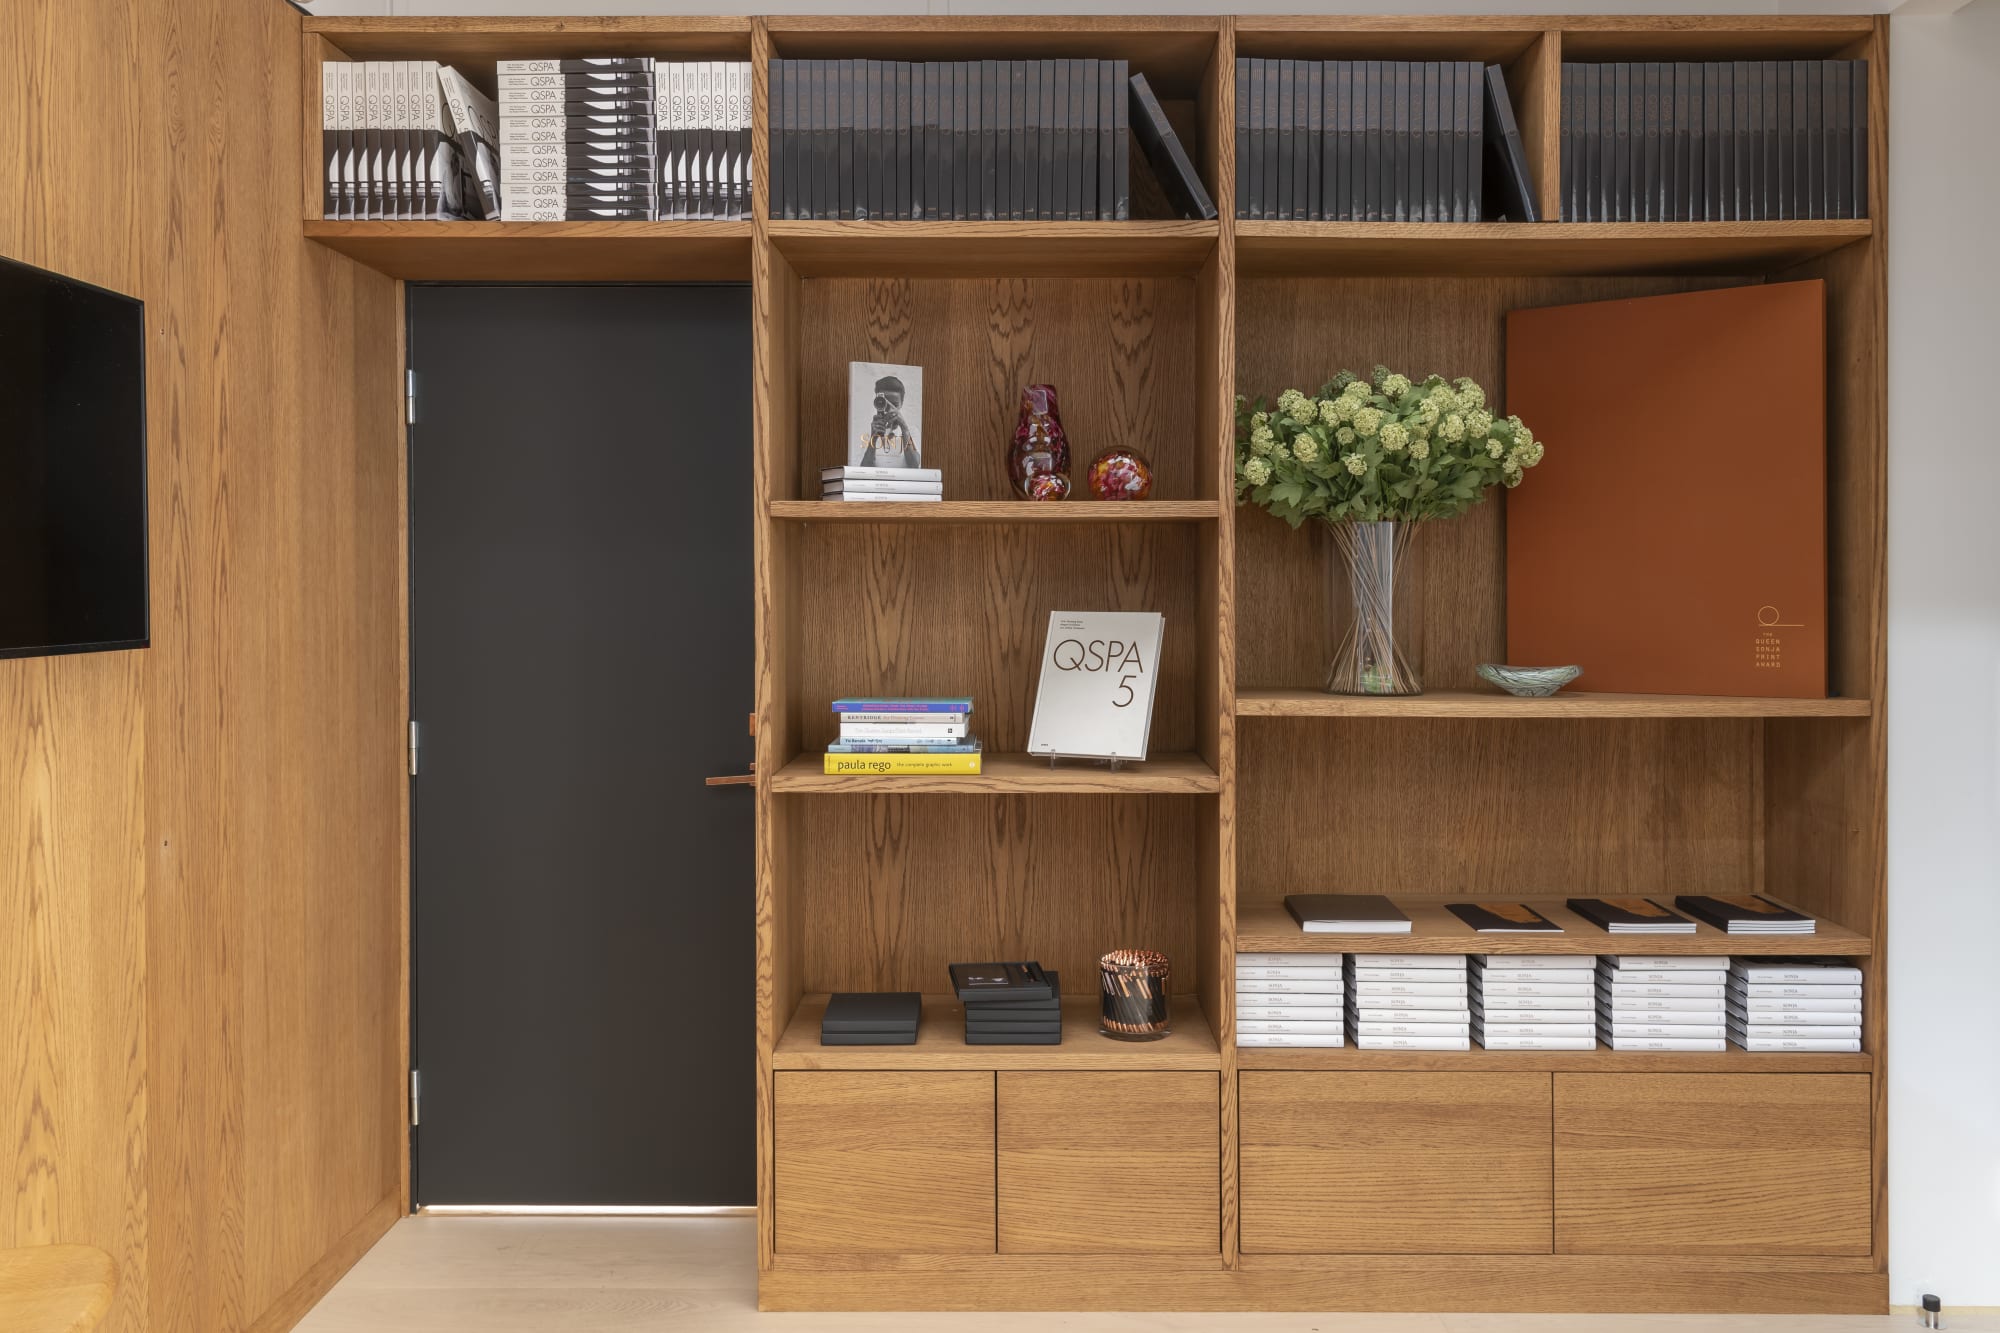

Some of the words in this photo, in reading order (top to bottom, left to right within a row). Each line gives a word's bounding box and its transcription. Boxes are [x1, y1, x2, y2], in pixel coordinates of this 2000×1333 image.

[529, 62, 554, 71] QSPA
[531, 76, 556, 86] QSPA
[369, 95, 378, 121] QSPA
[383, 95, 392, 121] QSPA
[397, 95, 406, 121] QSPA
[411, 94, 420, 120] QSPA
[426, 94, 435, 120] QSPA
[531, 91, 556, 100] QSPA
[701, 95, 710, 121] QSPA
[714, 95, 723, 121] QSPA
[729, 95, 738, 121] QSPA
[326, 96, 335, 121] QSPA
[340, 96, 349, 121] QSPA
[355, 96, 364, 121] QSPA
[450, 99, 465, 125] QSPA
[531, 105, 556, 114] QSPA
[658, 96, 667, 121] QSPA
[673, 96, 681, 121] QSPA
[687, 96, 696, 121] QSPA
[743, 96, 752, 121] QSPA
[532, 119, 557, 128] QSPA
[532, 132, 557, 141] QSPA
[532, 146, 558, 154] QSPA
[533, 158, 558, 167] QSPA
[533, 172, 558, 181] QSPA
[532, 186, 558, 195] QSPA
[534, 199, 558, 208] QSPA
[533, 212, 558, 221] QSPA
[1053, 639, 1144, 673] QSPA
[1112, 675, 1137, 708] 5
[838, 760, 866, 772] paula
[868, 762, 891, 772] rego
